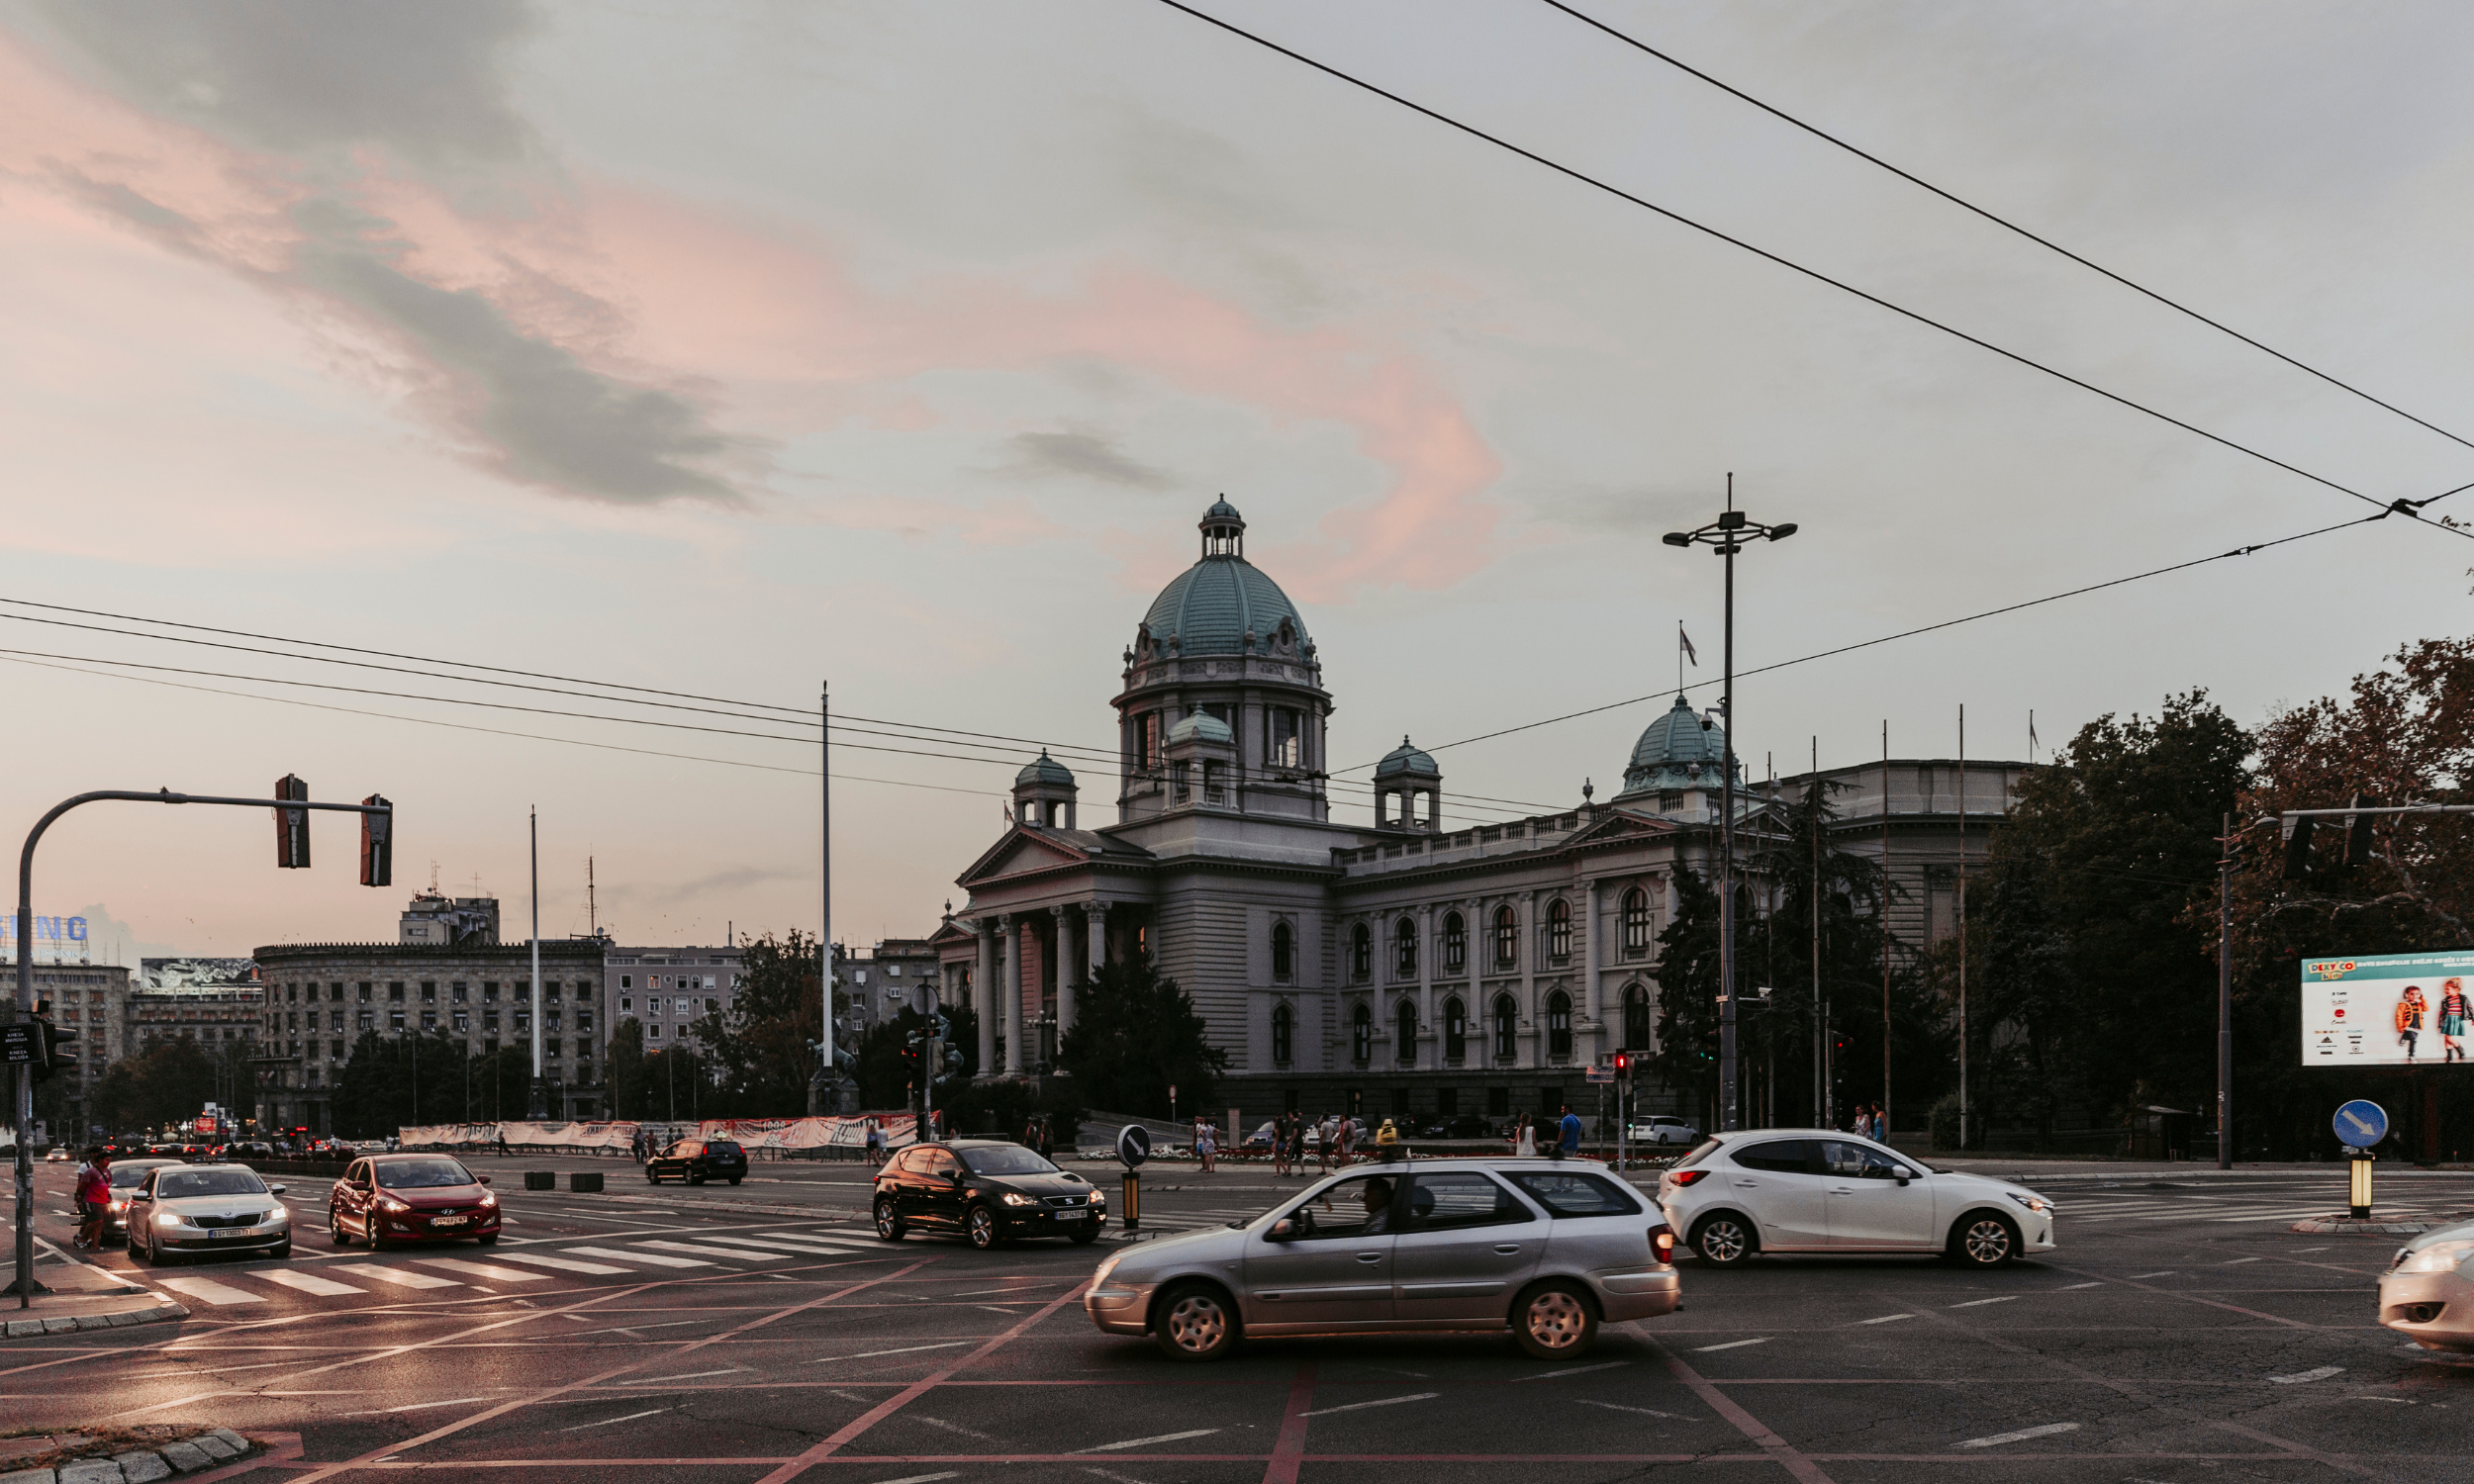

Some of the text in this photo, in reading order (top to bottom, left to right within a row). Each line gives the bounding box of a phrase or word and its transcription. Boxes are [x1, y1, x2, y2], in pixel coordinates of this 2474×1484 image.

[0, 915, 87, 941] NG
[39, 948, 90, 959] BANKA
[2311, 962, 2353, 972] DEXY CO
